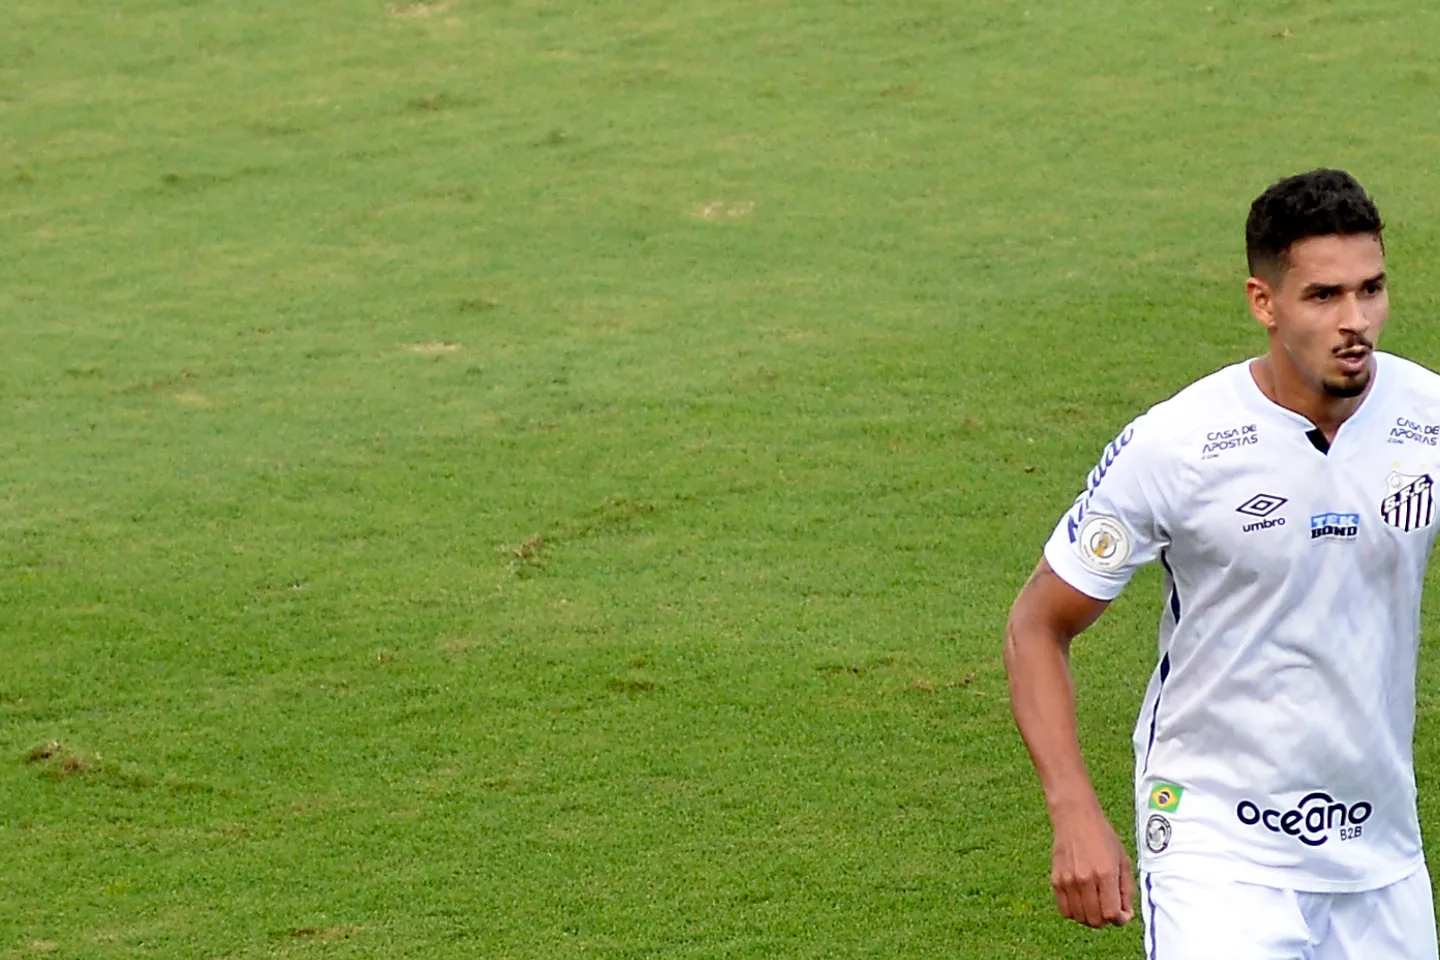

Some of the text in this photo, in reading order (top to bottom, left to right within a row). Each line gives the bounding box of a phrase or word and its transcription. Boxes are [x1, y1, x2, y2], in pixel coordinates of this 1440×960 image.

[1206, 424, 1257, 441] CASA DE
[1397, 416, 1440, 436] CASA DE
[1202, 433, 1258, 453] APOSTAS
[1390, 427, 1438, 447] APOSTAS
[1242, 517, 1286, 532] umbro
[1311, 514, 1356, 528] TEK
[1311, 525, 1358, 539] BOND
[1236, 793, 1373, 846] oceano
[1340, 826, 1362, 841] B2B
